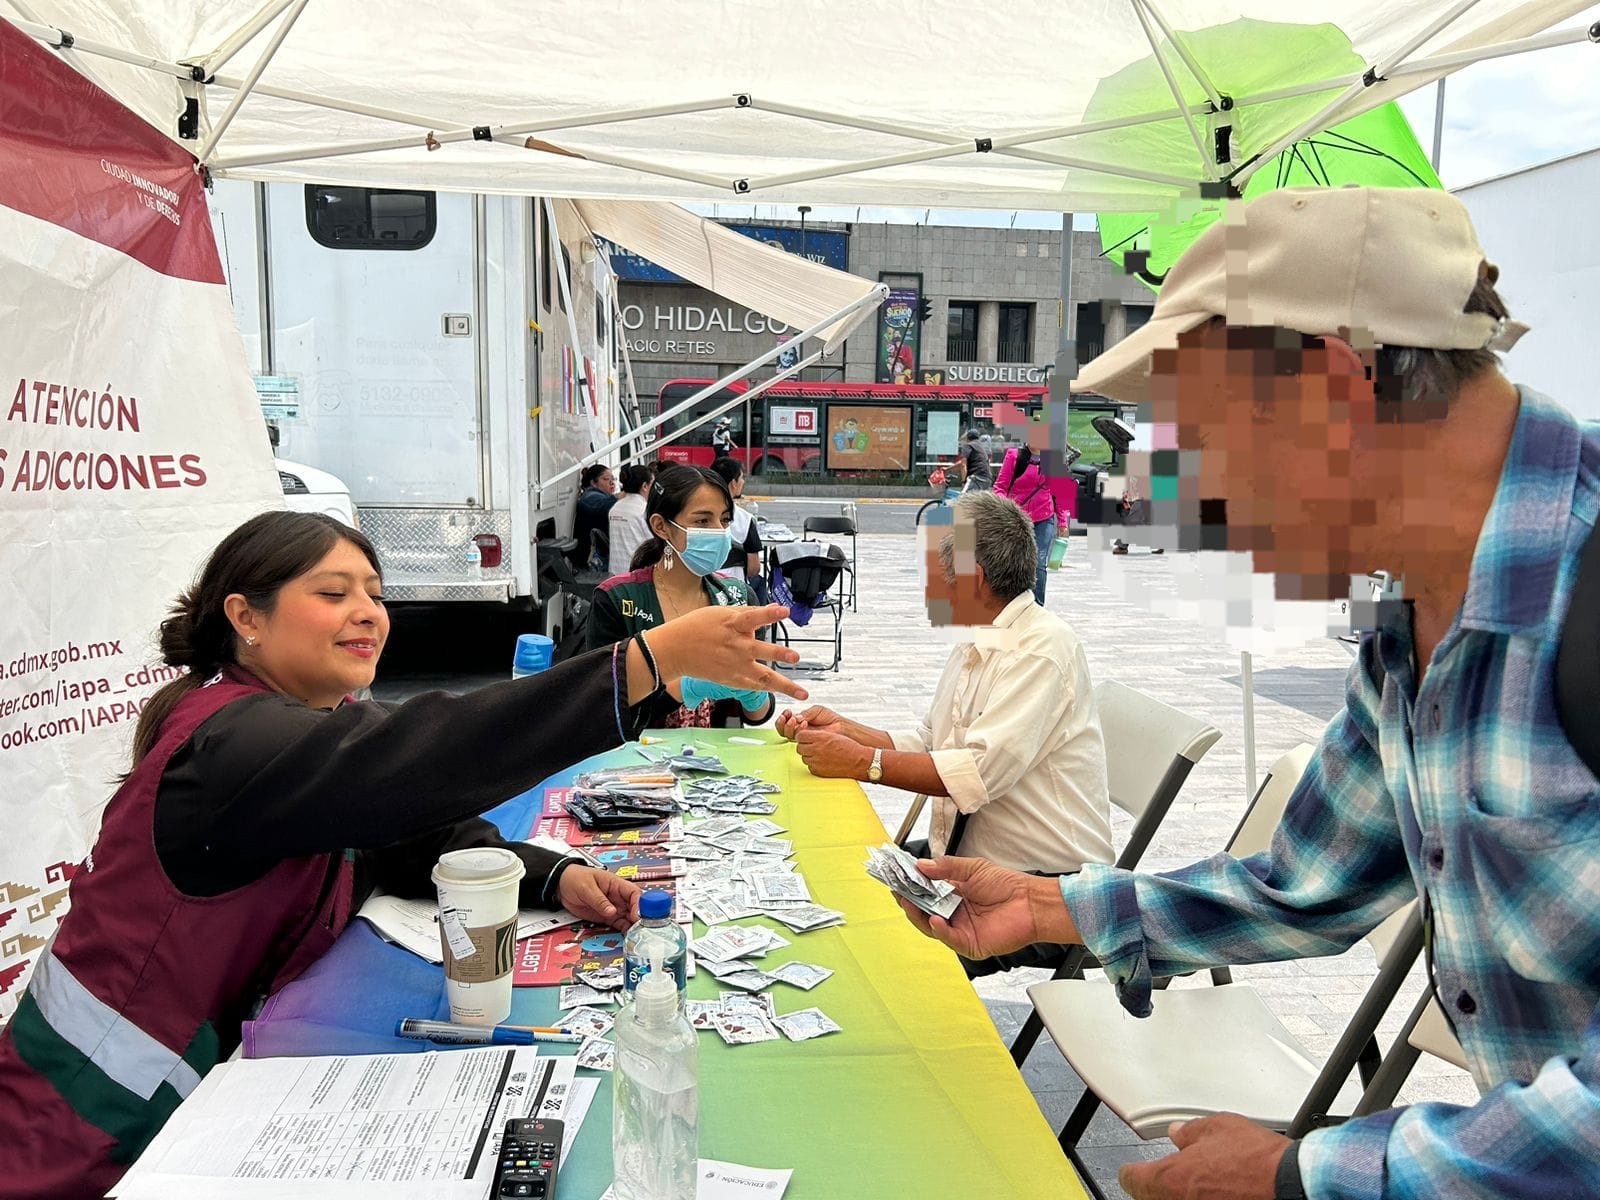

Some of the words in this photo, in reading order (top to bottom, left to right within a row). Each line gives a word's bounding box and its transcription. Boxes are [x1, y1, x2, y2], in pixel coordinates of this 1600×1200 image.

[101, 158, 132, 184] CIUDAD
[136, 190, 143, 204] Y
[144, 194, 156, 210] DE
[654, 305, 789, 335] HIDALGO
[665, 340, 715, 355] RETES
[7, 378, 141, 433] ATENCIÓN
[11, 449, 208, 492] ADICCIONES
[721, 1176, 764, 1188] EDUCACIÓN
